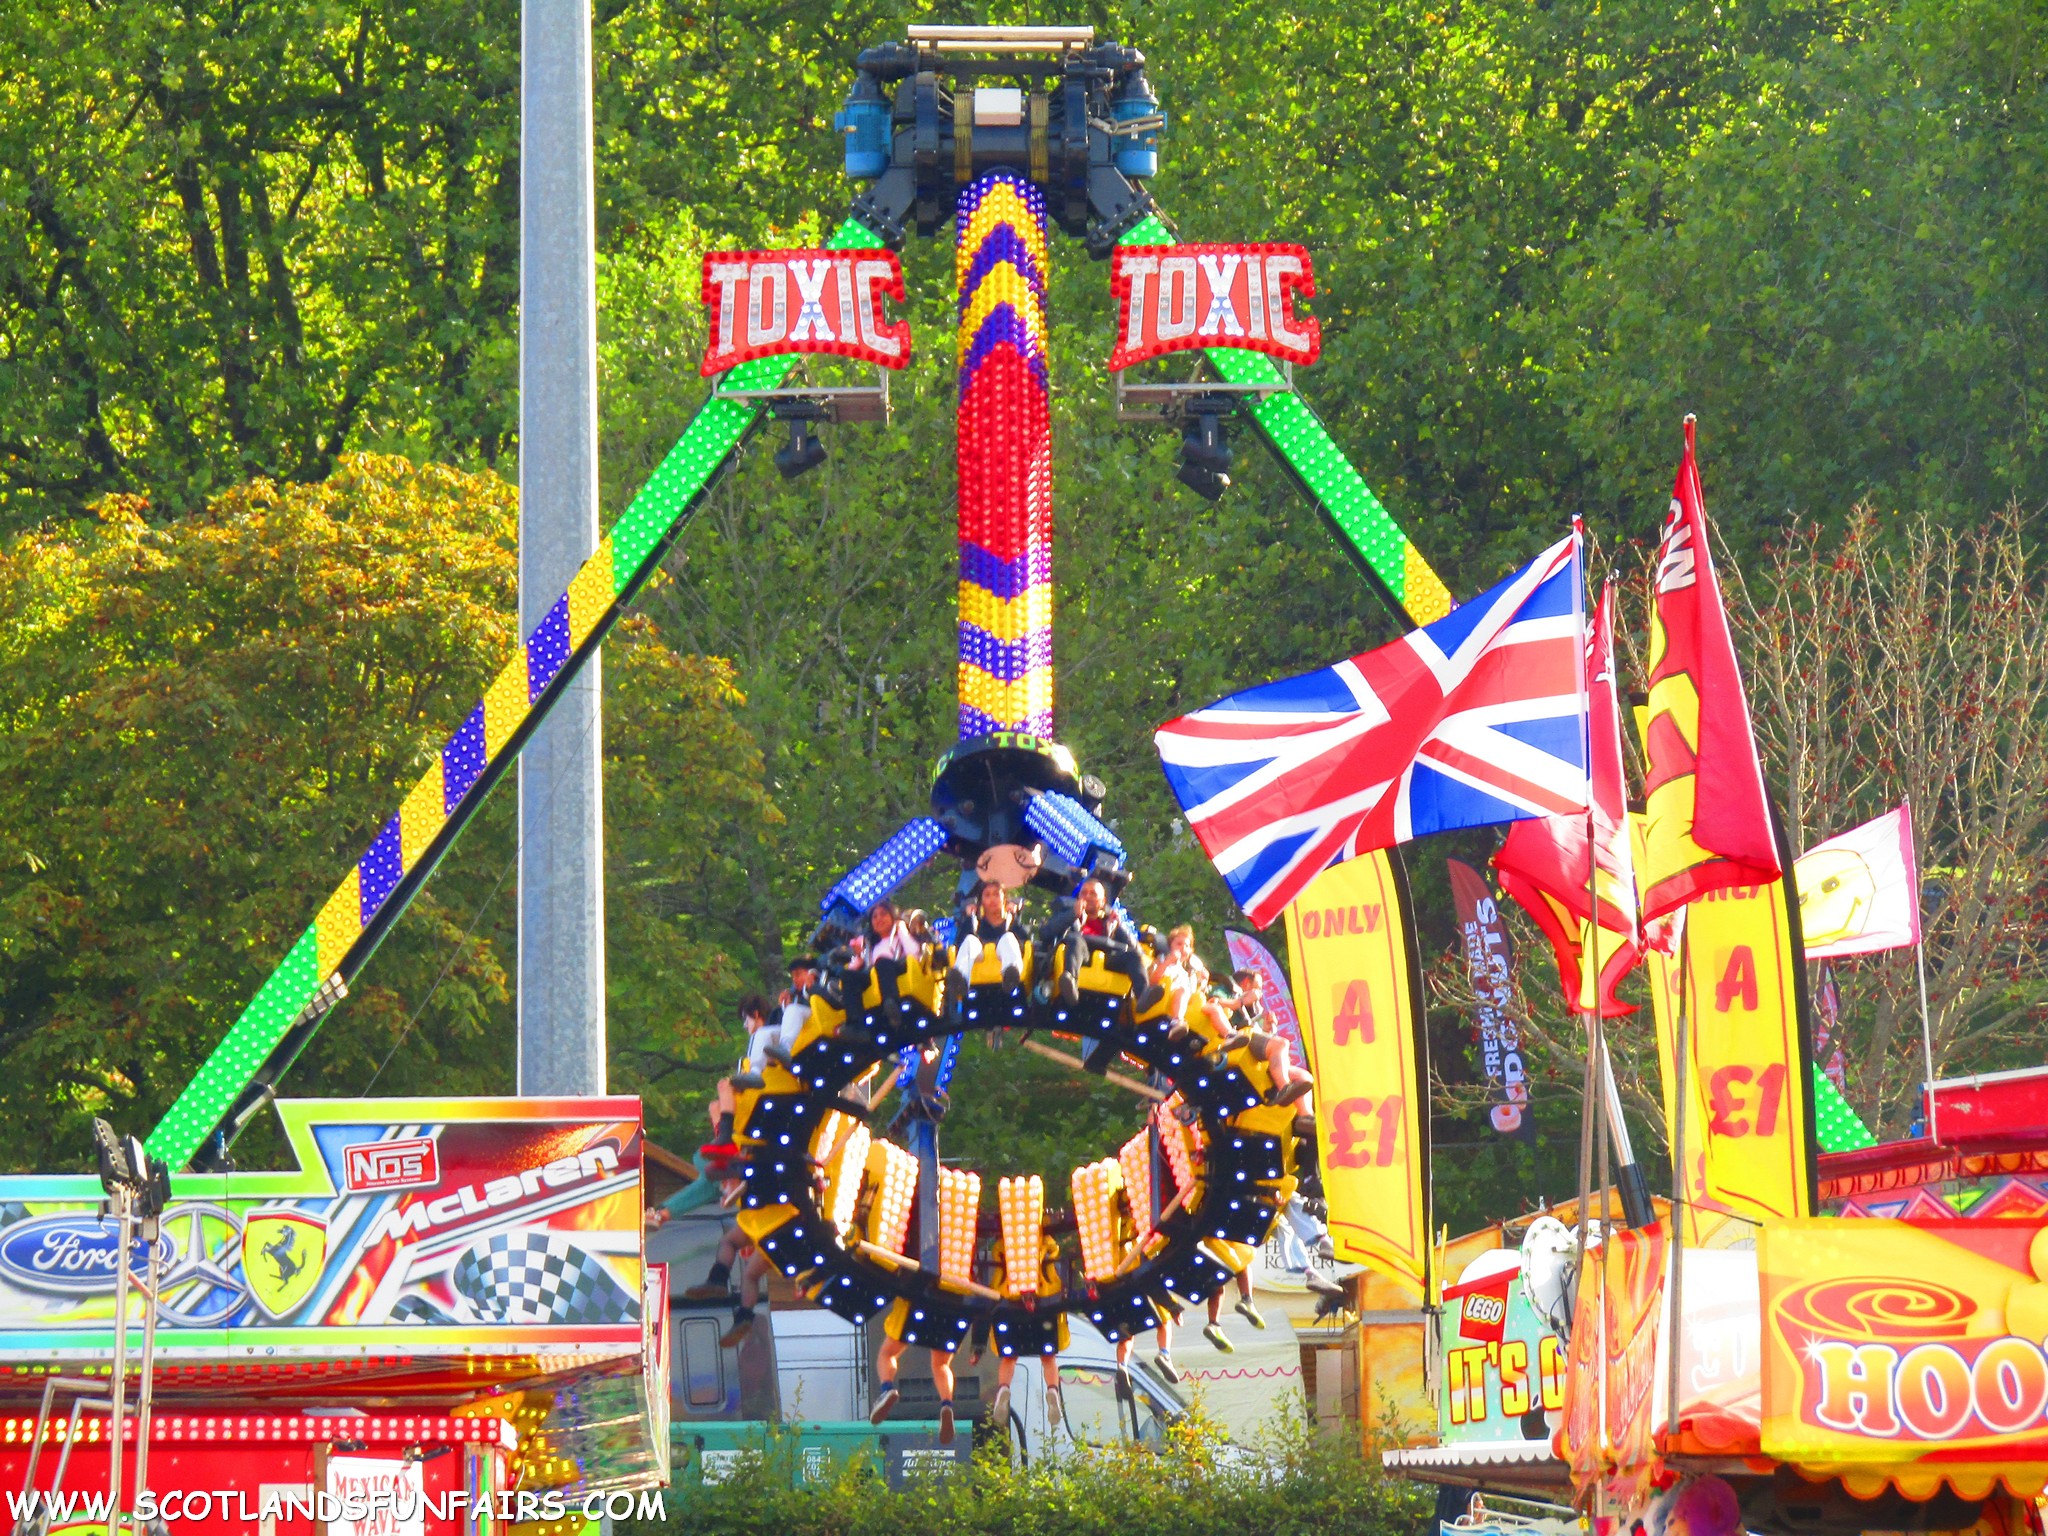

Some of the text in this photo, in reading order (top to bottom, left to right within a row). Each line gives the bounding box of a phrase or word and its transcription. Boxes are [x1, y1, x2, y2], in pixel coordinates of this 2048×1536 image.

[709, 258, 901, 358] TOXIC
[1119, 254, 1311, 353] TOXIC
[1301, 903, 1382, 940] ONLY
[1332, 979, 1376, 1047] A
[1715, 944, 1759, 1013] A
[1327, 1095, 1403, 1169] £1
[1709, 1063, 1787, 1138] £1
[353, 1146, 428, 1182] NOS
[362, 1145, 619, 1249] McLaren
[1464, 1296, 1504, 1323] LEGO
[1447, 1340, 1531, 1425] IT'S
[1813, 1336, 2048, 1441] HOO
[333, 1471, 415, 1502] MEXICAN
[351, 1508, 402, 1536] WAVE
